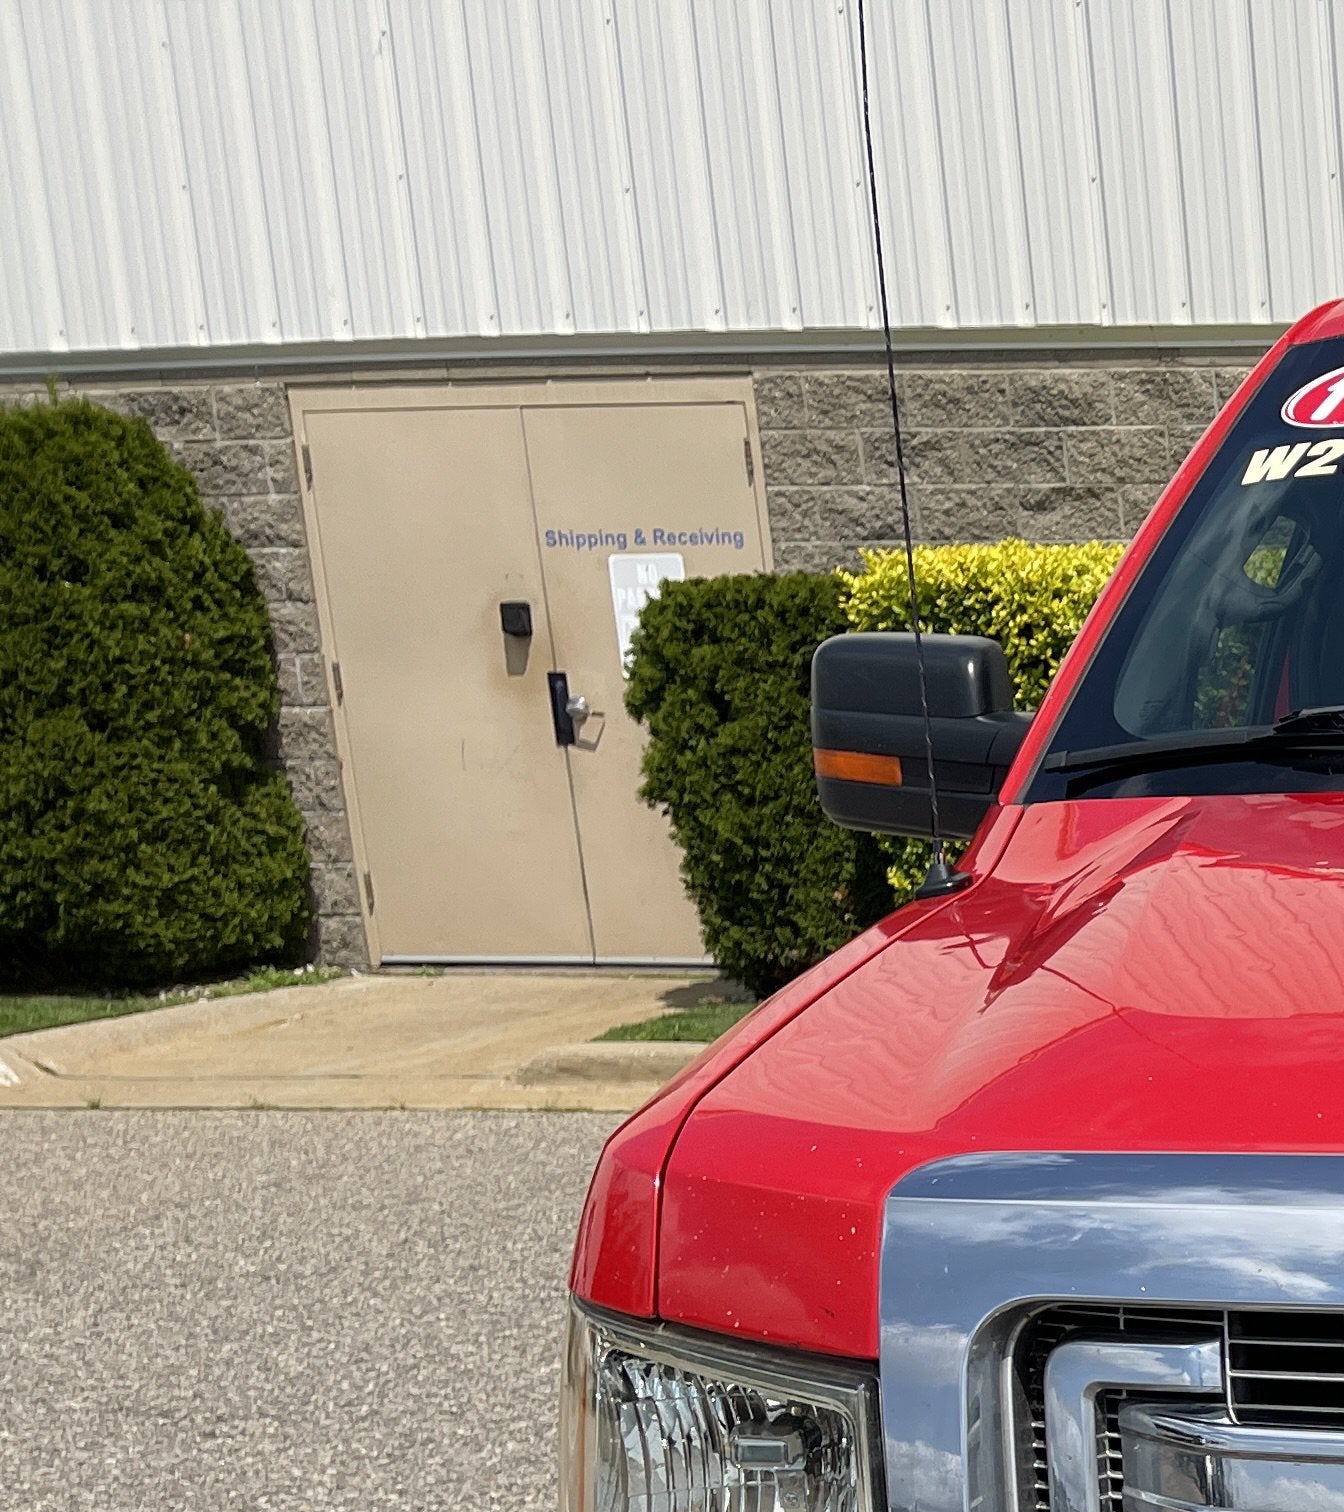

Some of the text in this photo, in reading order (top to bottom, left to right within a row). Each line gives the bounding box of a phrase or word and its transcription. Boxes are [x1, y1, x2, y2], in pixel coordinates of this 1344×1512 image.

[544, 526, 745, 550] Shipping & Receiving
